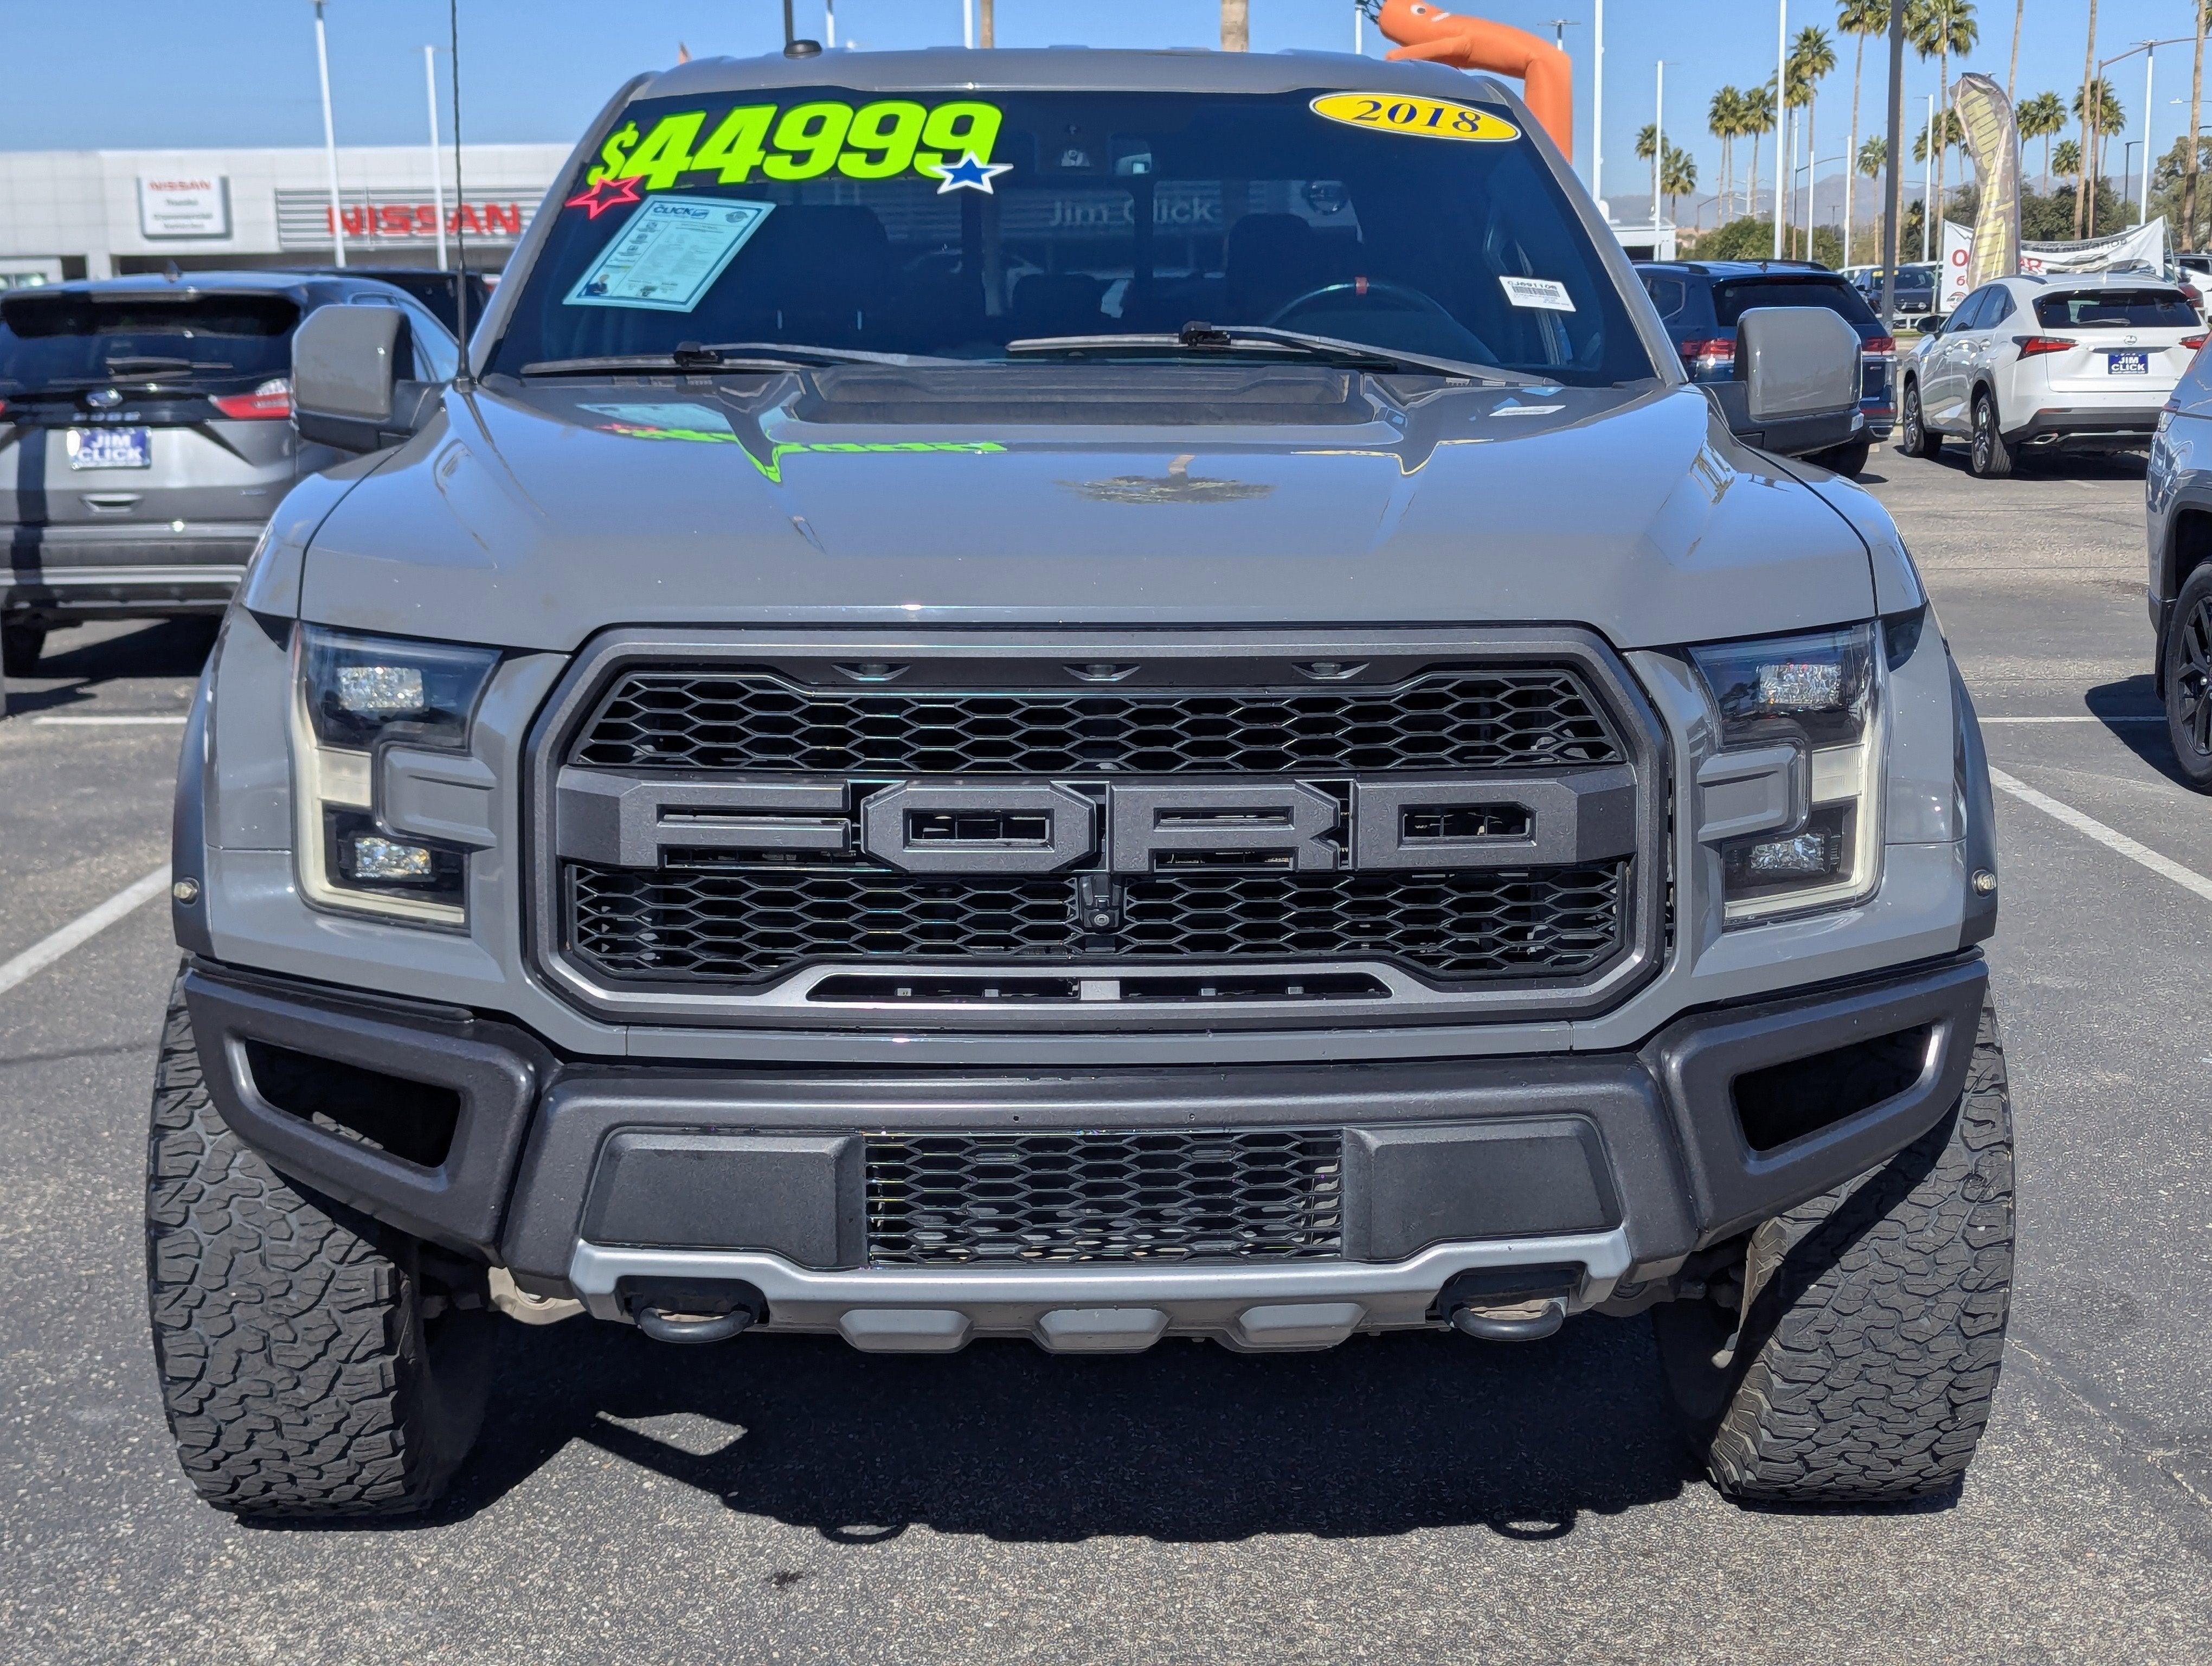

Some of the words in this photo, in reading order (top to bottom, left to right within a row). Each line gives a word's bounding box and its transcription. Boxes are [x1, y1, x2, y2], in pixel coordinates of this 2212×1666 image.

[1352, 100, 1482, 133] 2018
[587, 100, 1002, 191] $44999
[327, 202, 521, 236] NISSAN
[1049, 199, 1109, 226] Jim
[78, 446, 143, 462] CLICK
[91, 434, 131, 448] JIM
[621, 779, 1577, 873] FORD
